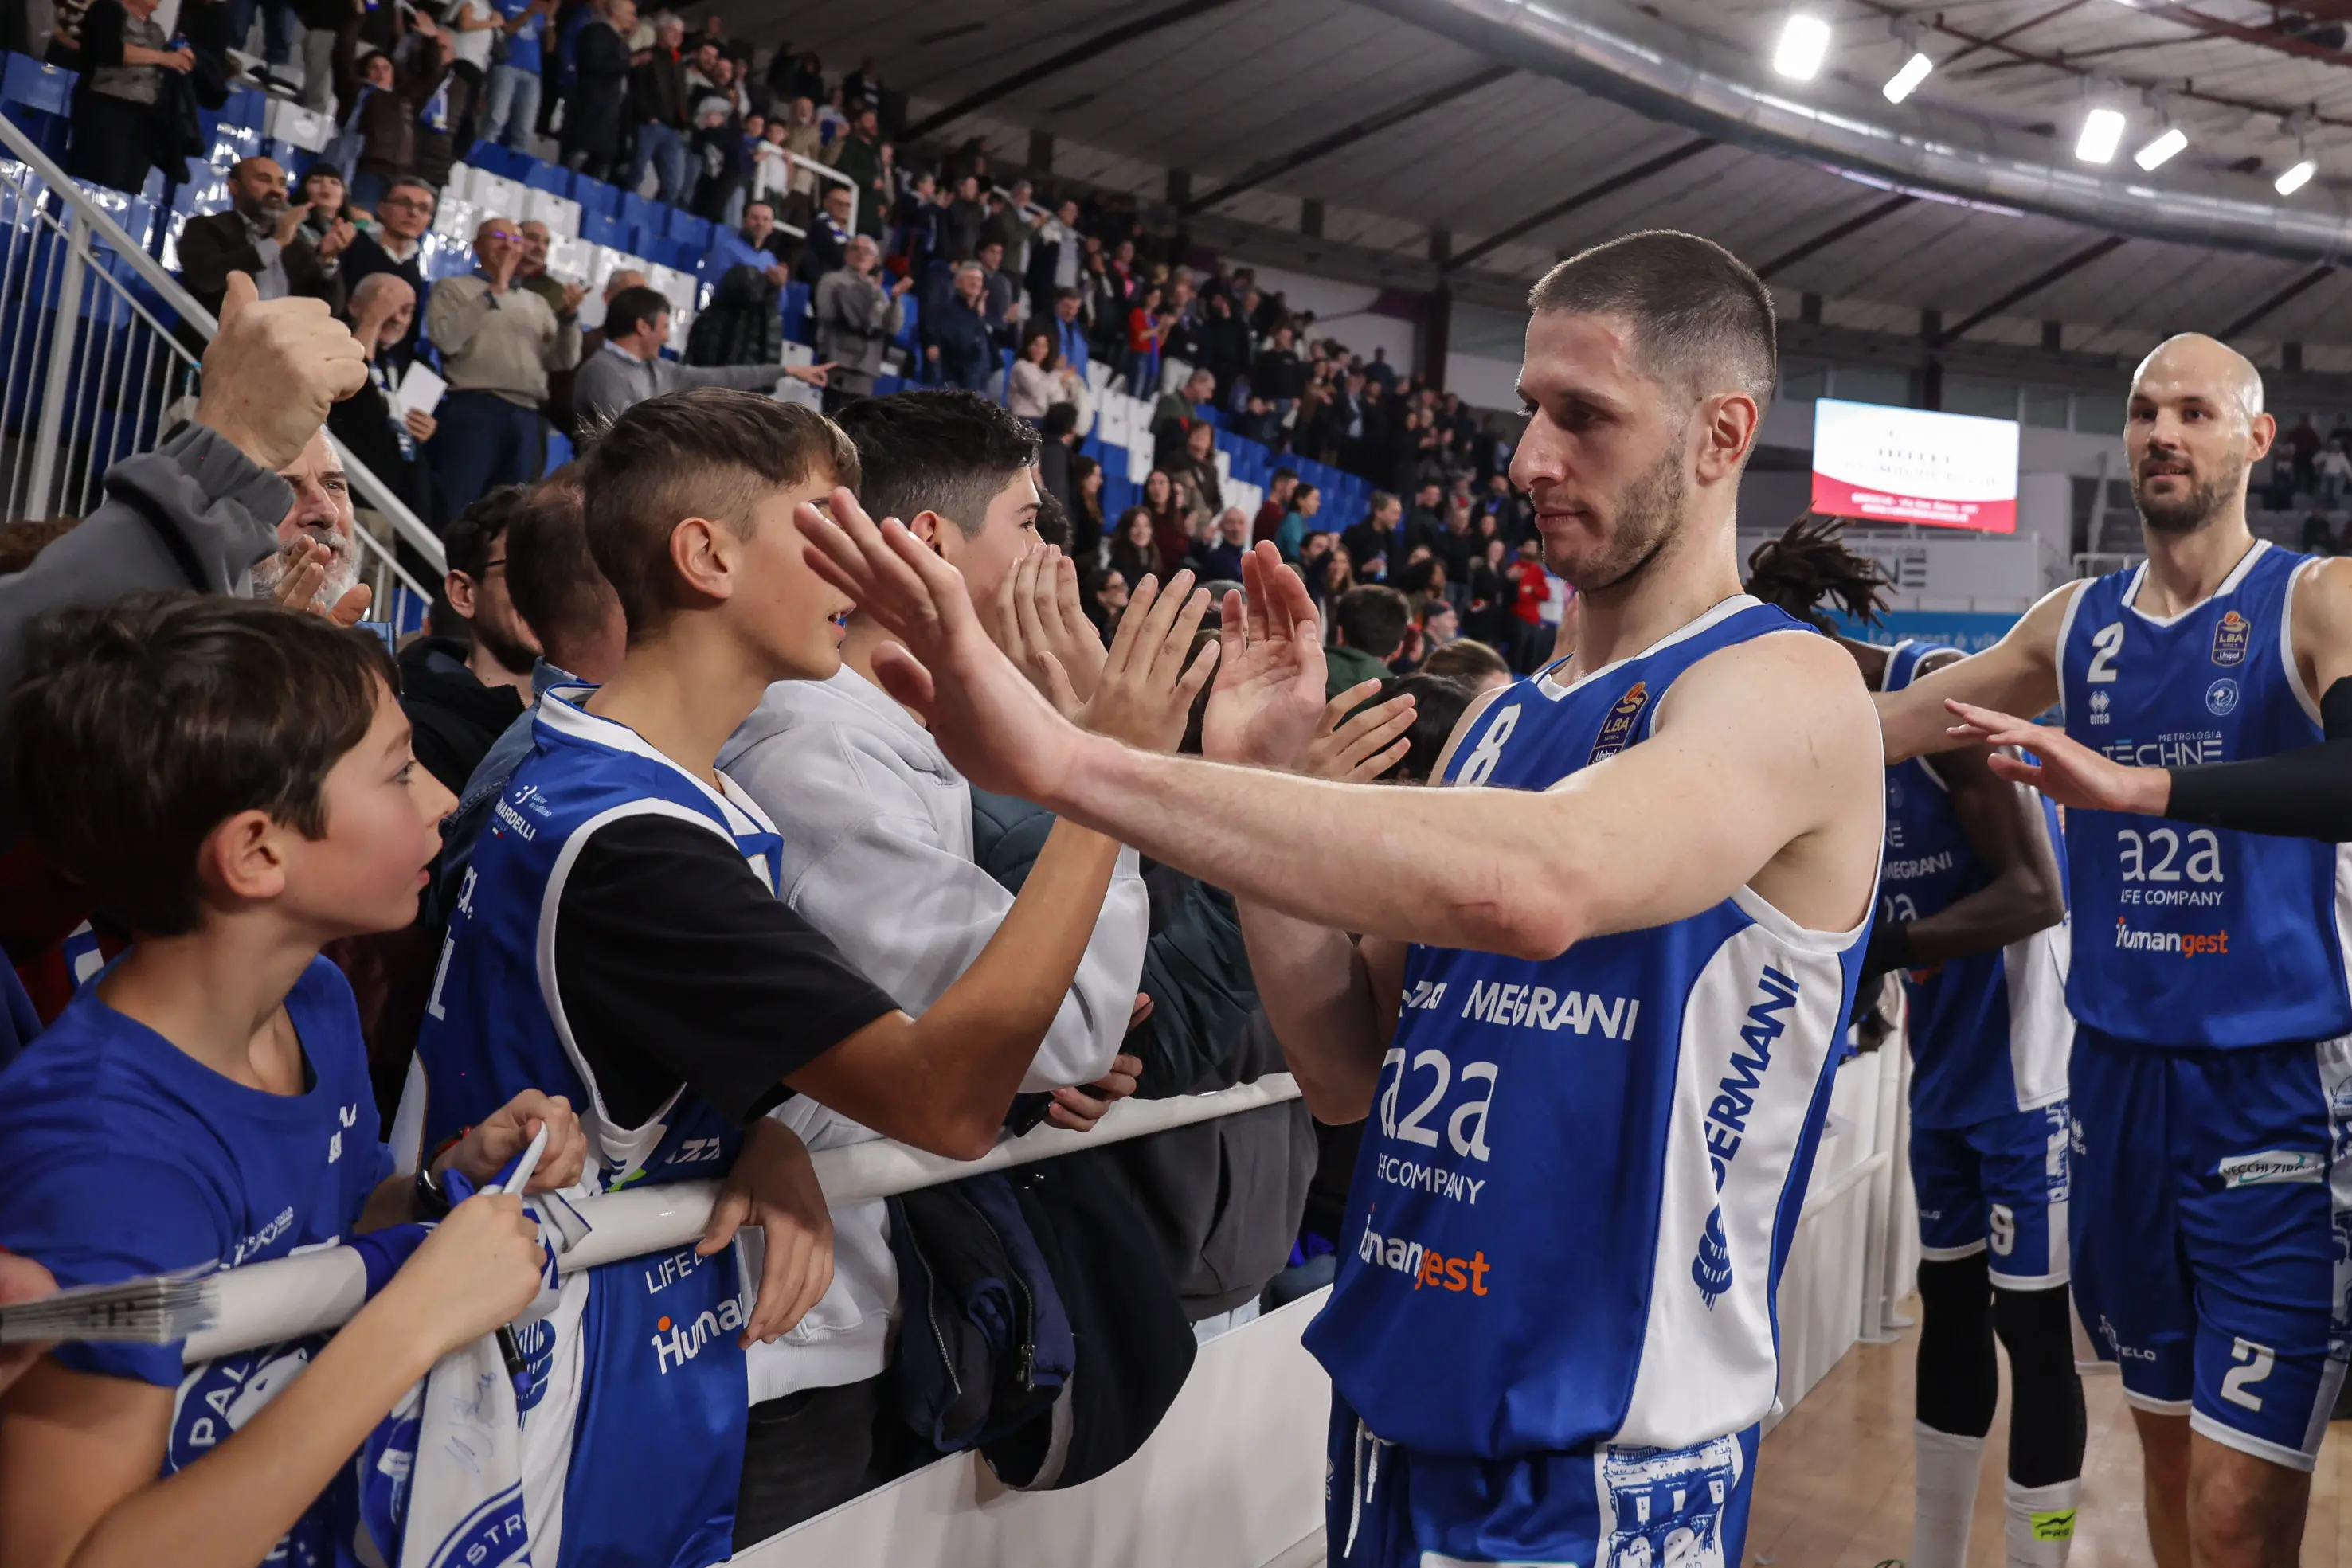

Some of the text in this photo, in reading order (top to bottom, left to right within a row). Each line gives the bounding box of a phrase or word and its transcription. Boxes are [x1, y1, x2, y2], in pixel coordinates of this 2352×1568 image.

[2087, 621, 2124, 683] 2
[2219, 633, 2244, 643] LBA
[1454, 702, 1522, 787] 8
[1603, 717, 1630, 733] LBA
[2158, 730, 2222, 743] METROLOGIA
[2117, 827, 2225, 883] a2a
[2144, 890, 2225, 906] COMPANY
[1461, 980, 1641, 1042] MEGRANI
[1380, 1047, 1499, 1163] a2a
[1386, 1158, 1486, 1205] COMPANY
[1990, 1203, 2016, 1256] 9
[644, 1251, 693, 1296] LIFE
[652, 1292, 743, 1376] Huma
[2221, 1336, 2276, 1412] 2
